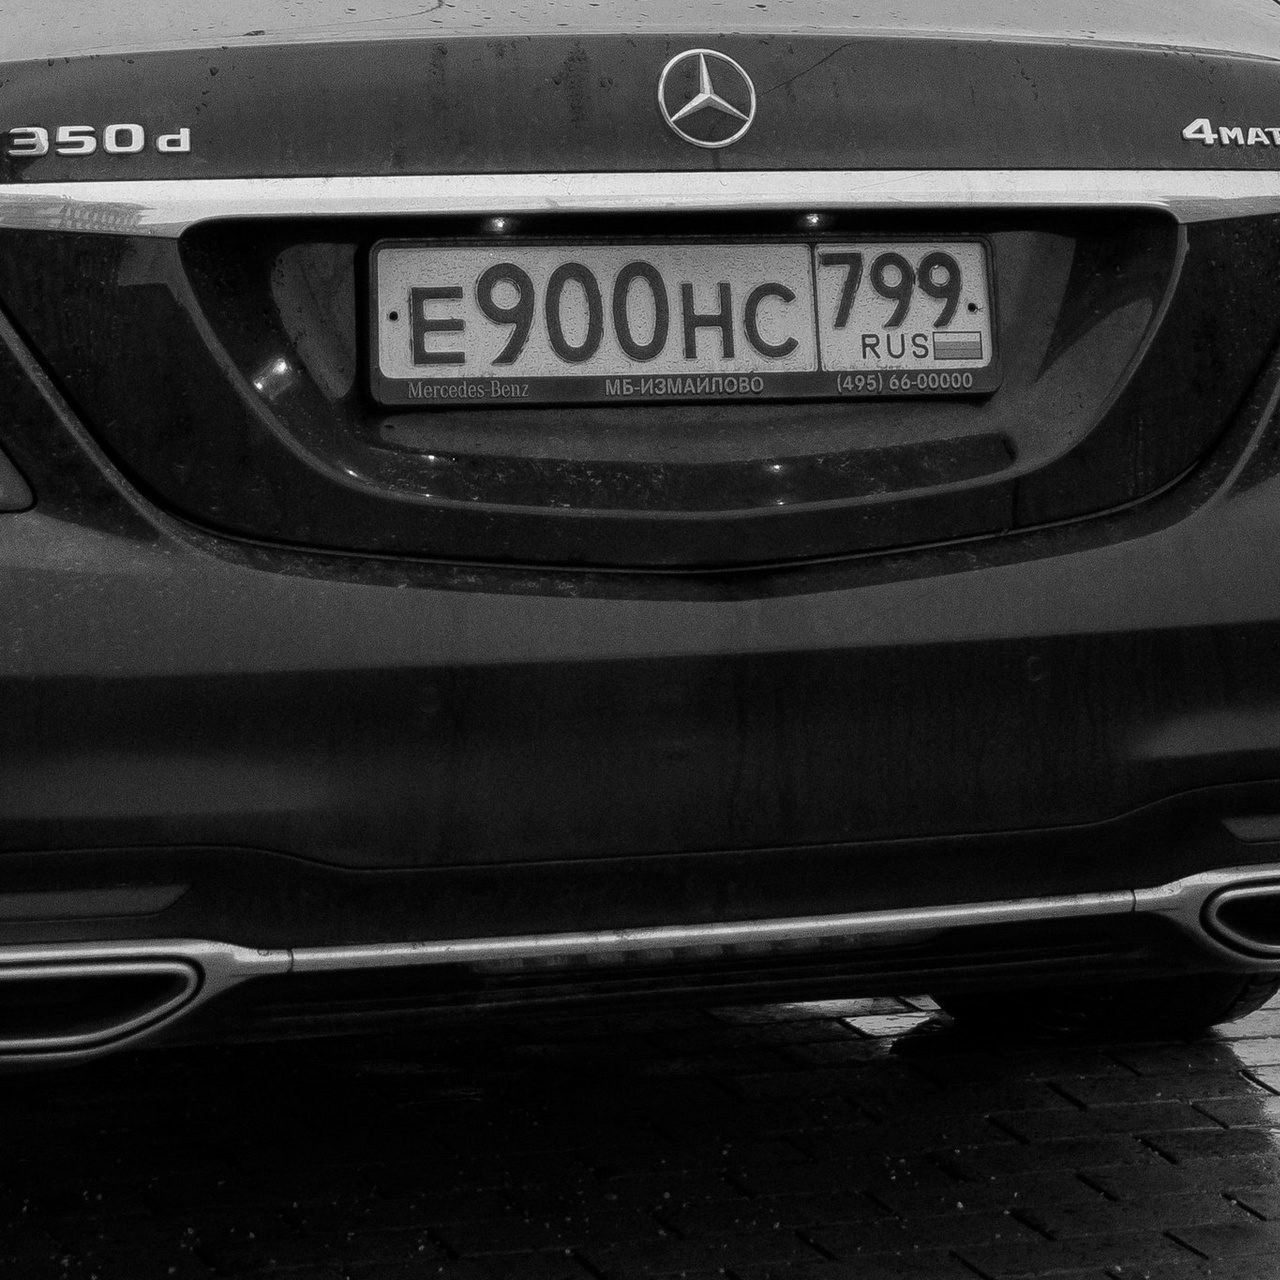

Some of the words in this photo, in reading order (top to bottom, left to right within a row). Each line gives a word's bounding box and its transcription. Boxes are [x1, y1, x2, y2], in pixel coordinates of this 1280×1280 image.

[820, 251, 962, 329] 799
[861, 333, 929, 359] RUS
[408, 380, 530, 399] Mercedes-Benz
[605, 375, 765, 396] МБ-ИЗМАЙЛОВО
[836, 373, 883, 395] (495)
[889, 372, 973, 391] 66-00000
